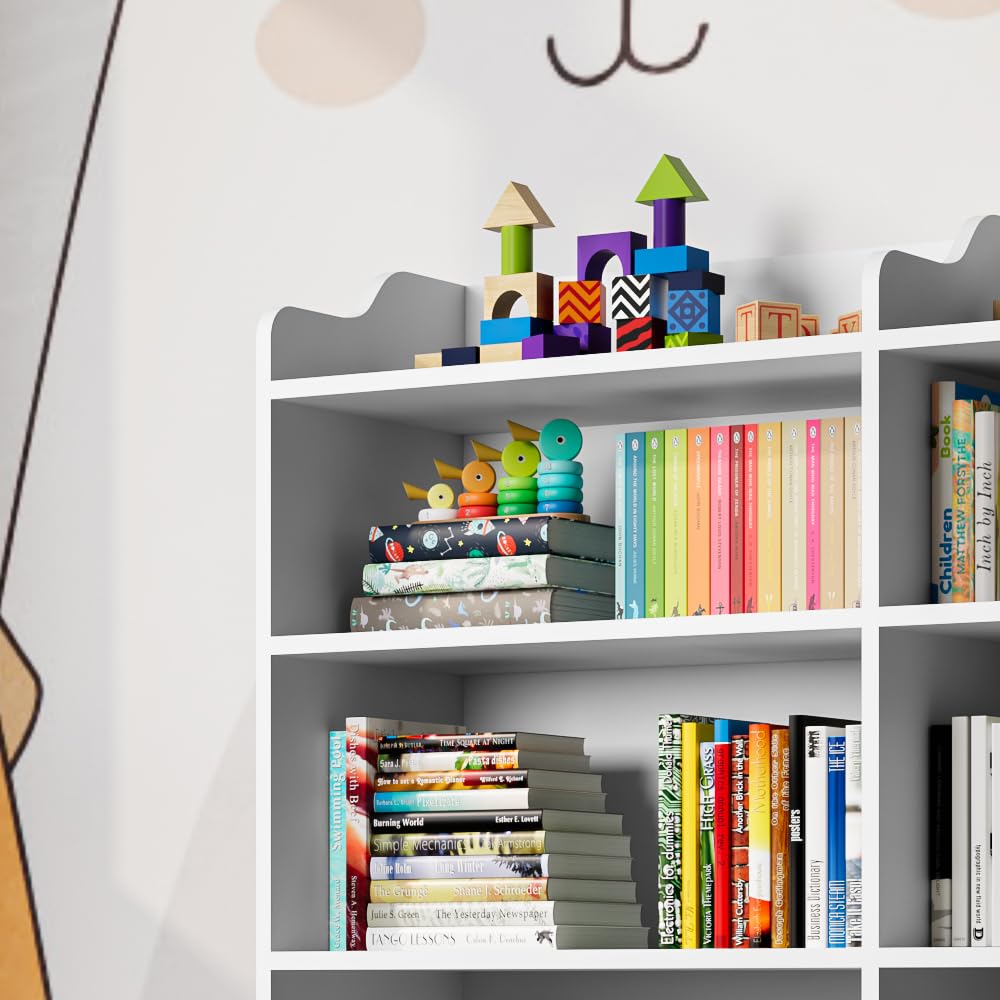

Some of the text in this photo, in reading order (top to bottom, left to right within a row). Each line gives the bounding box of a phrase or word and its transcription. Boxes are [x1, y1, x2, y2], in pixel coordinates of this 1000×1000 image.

[768, 312, 792, 338] T
[940, 415, 951, 458] Book
[957, 438, 967, 575] MATTHEW FORSYTHE
[977, 460, 994, 572] Inch by Inch
[939, 508, 952, 594] Children
[349, 723, 360, 763] Dishes
[440, 738, 514, 748] TIME SQUARE AT NIGHT
[735, 739, 743, 757] Wall
[379, 760, 394, 768] Sara
[468, 755, 489, 765] Pasta
[491, 754, 514, 765] dishes
[735, 759, 743, 770] the
[829, 741, 845, 773] THE ICE
[349, 766, 360, 791] with
[751, 730, 767, 814] Motherhood
[330, 735, 345, 851] Swimming Pool
[700, 748, 714, 831] HIGH GRASS
[735, 781, 743, 800] Brick
[373, 819, 401, 829] Burning
[402, 818, 424, 826] World
[735, 801, 743, 833] Another
[789, 809, 803, 842] posters
[373, 839, 408, 852] Simple
[497, 838, 542, 850] Armstrong
[456, 860, 484, 873] Winter
[662, 811, 674, 945] Electronics for dummies
[350, 876, 358, 899] Steven
[373, 884, 543, 898] The Grunge Schroeder
[808, 859, 821, 941] Business Dictionary
[370, 909, 389, 920] Julie
[397, 909, 420, 919] Green
[435, 909, 451, 919] The
[453, 909, 496, 921] Yesterday
[499, 909, 548, 921] Newspaper
[703, 910, 712, 945] VICTORIA
[371, 933, 408, 945] TANGO
[409, 933, 456, 946] LESSONS
[735, 917, 743, 945] William
[973, 927, 983, 941] D
